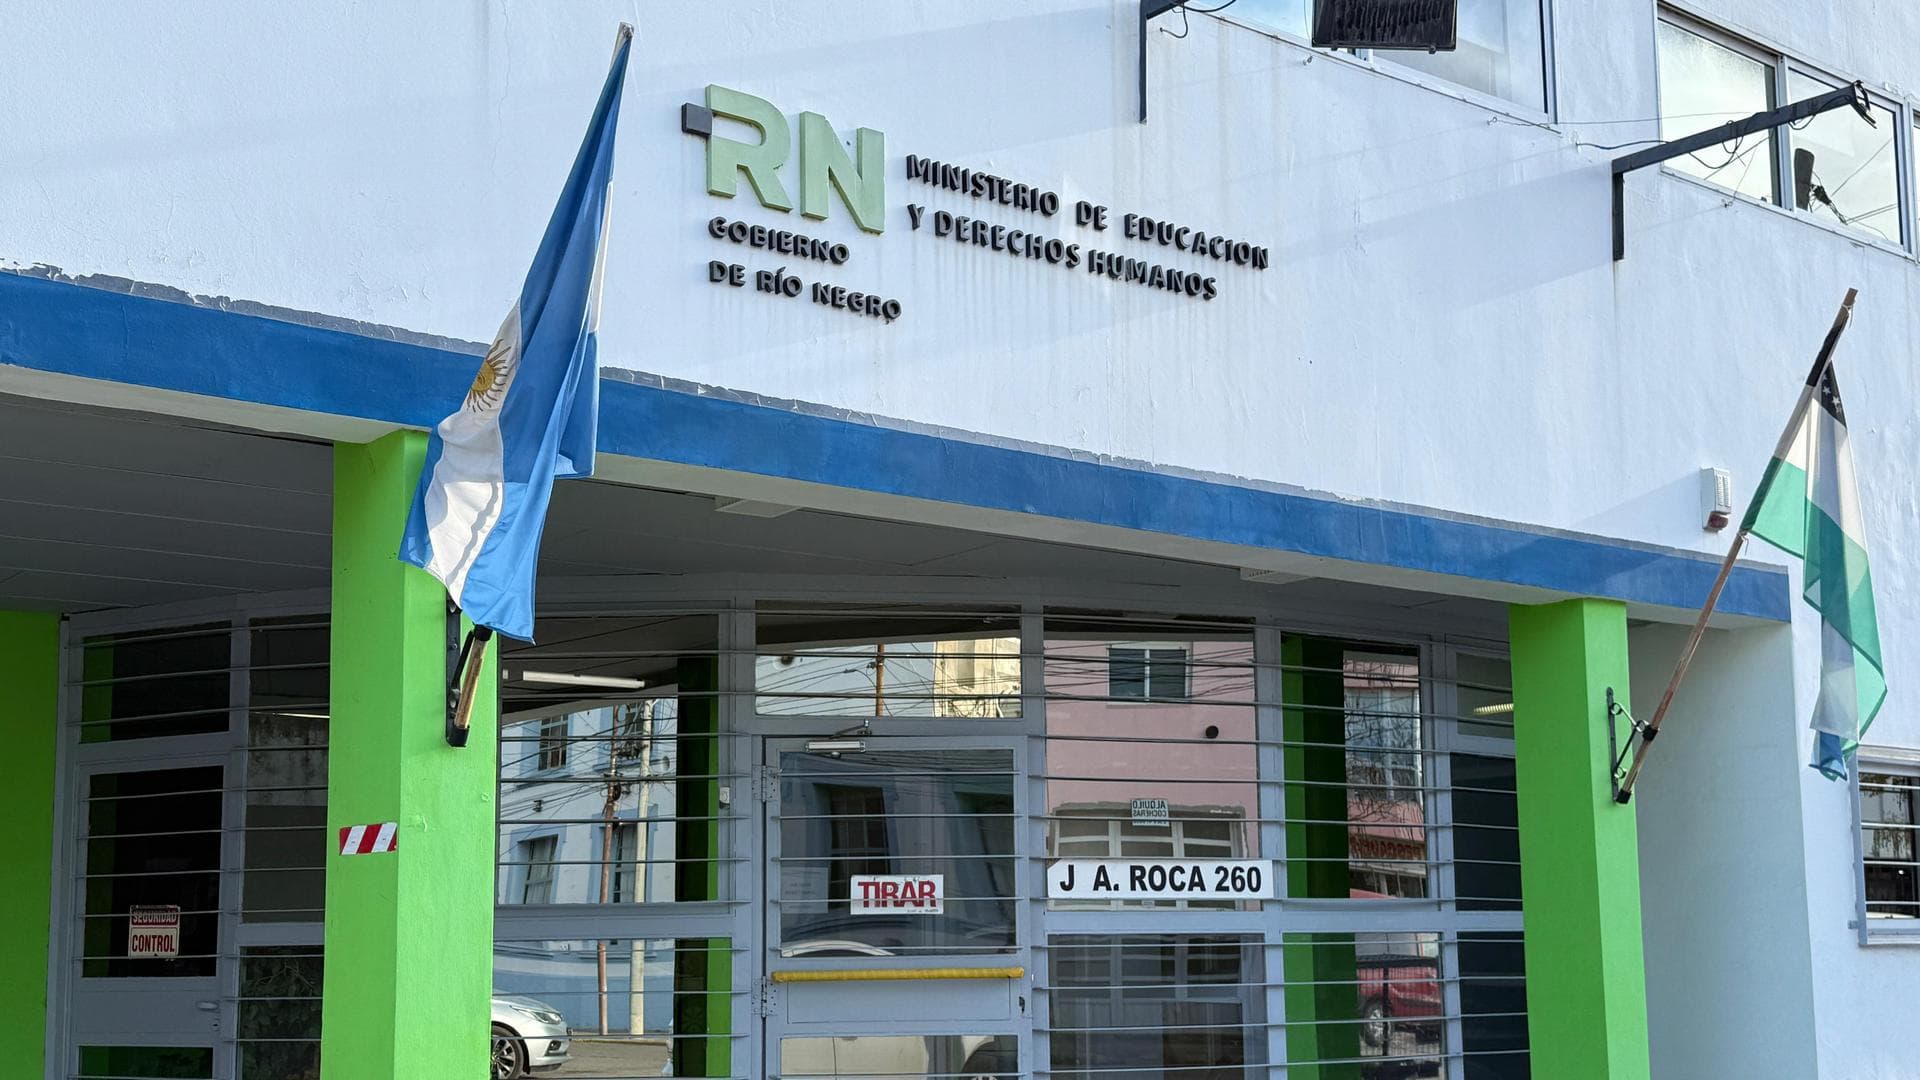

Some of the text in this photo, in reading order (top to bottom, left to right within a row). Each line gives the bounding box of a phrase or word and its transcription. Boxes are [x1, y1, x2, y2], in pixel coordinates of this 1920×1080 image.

[705, 84, 885, 234] RN
[907, 154, 1269, 269] MINISTERIO DE EDUCACION
[708, 216, 850, 265] GOBIERNO
[907, 204, 1217, 300] Y DERECHOS HUMANOS
[709, 261, 902, 323] DE RÍO NEGRO
[857, 880, 937, 908] TIRAR
[1060, 864, 1262, 893] J A. ROCA 260
[132, 911, 176, 923] SEGURIDAD
[132, 934, 175, 953] CONTROL
